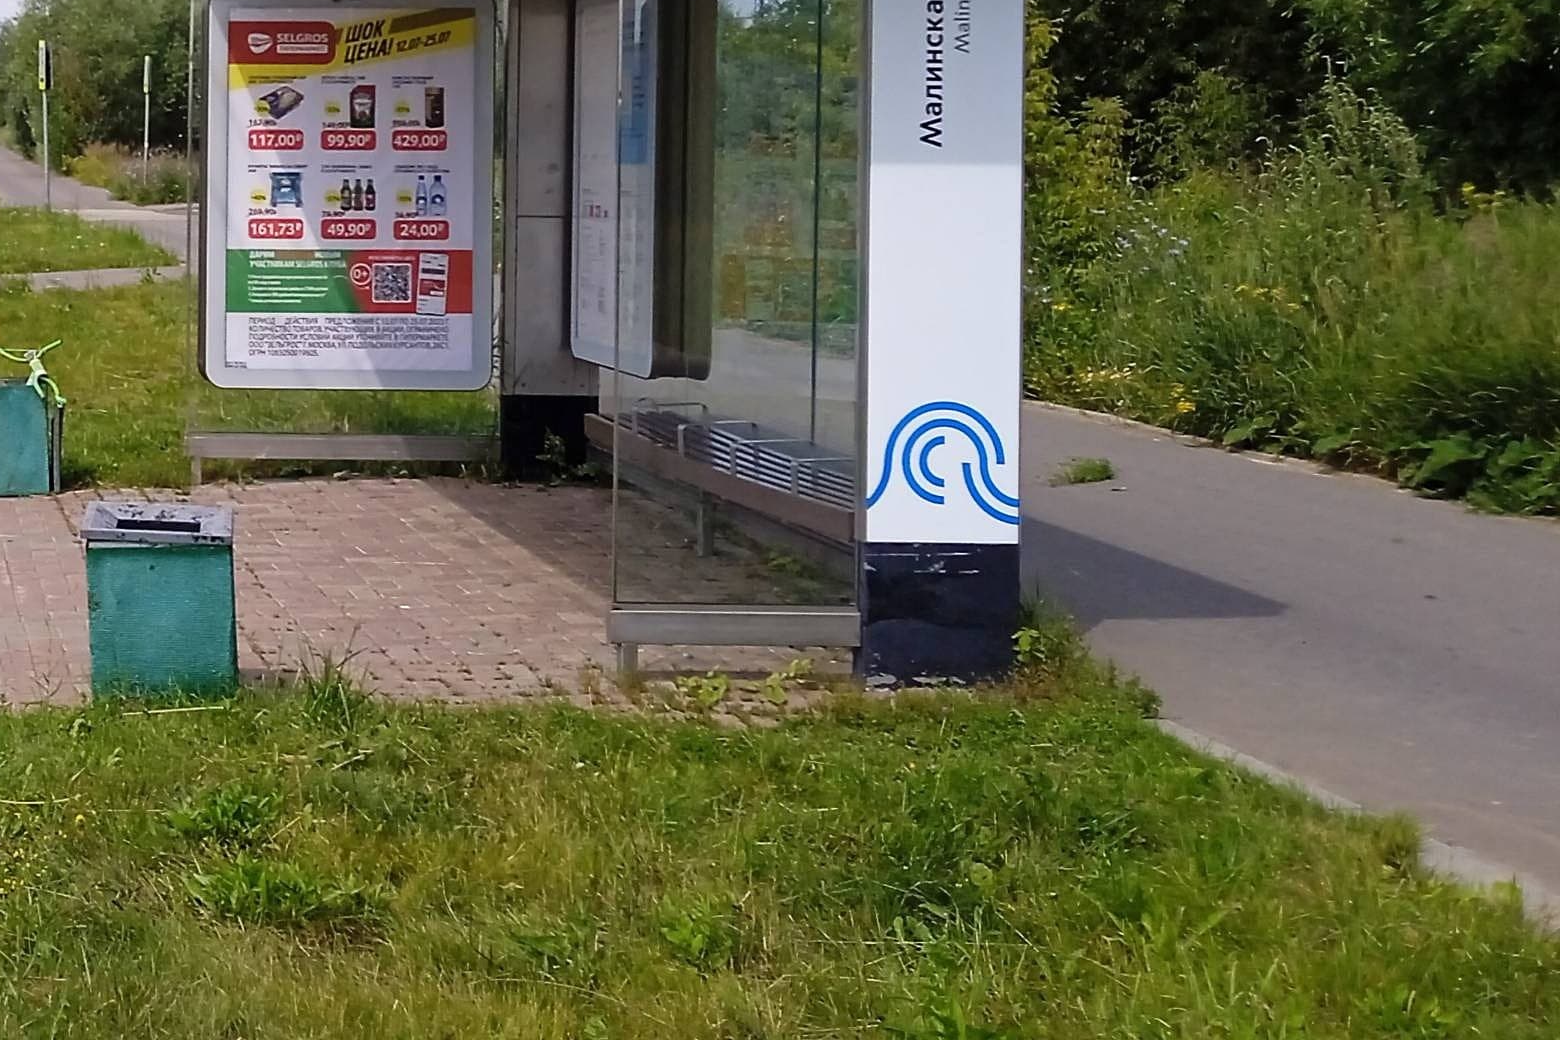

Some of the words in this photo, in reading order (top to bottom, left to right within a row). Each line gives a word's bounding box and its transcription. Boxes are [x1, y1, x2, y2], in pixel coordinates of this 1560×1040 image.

[276, 33, 329, 43] SELGROS
[345, 19, 385, 43] ШОК
[344, 38, 394, 64] ЦЕНА!
